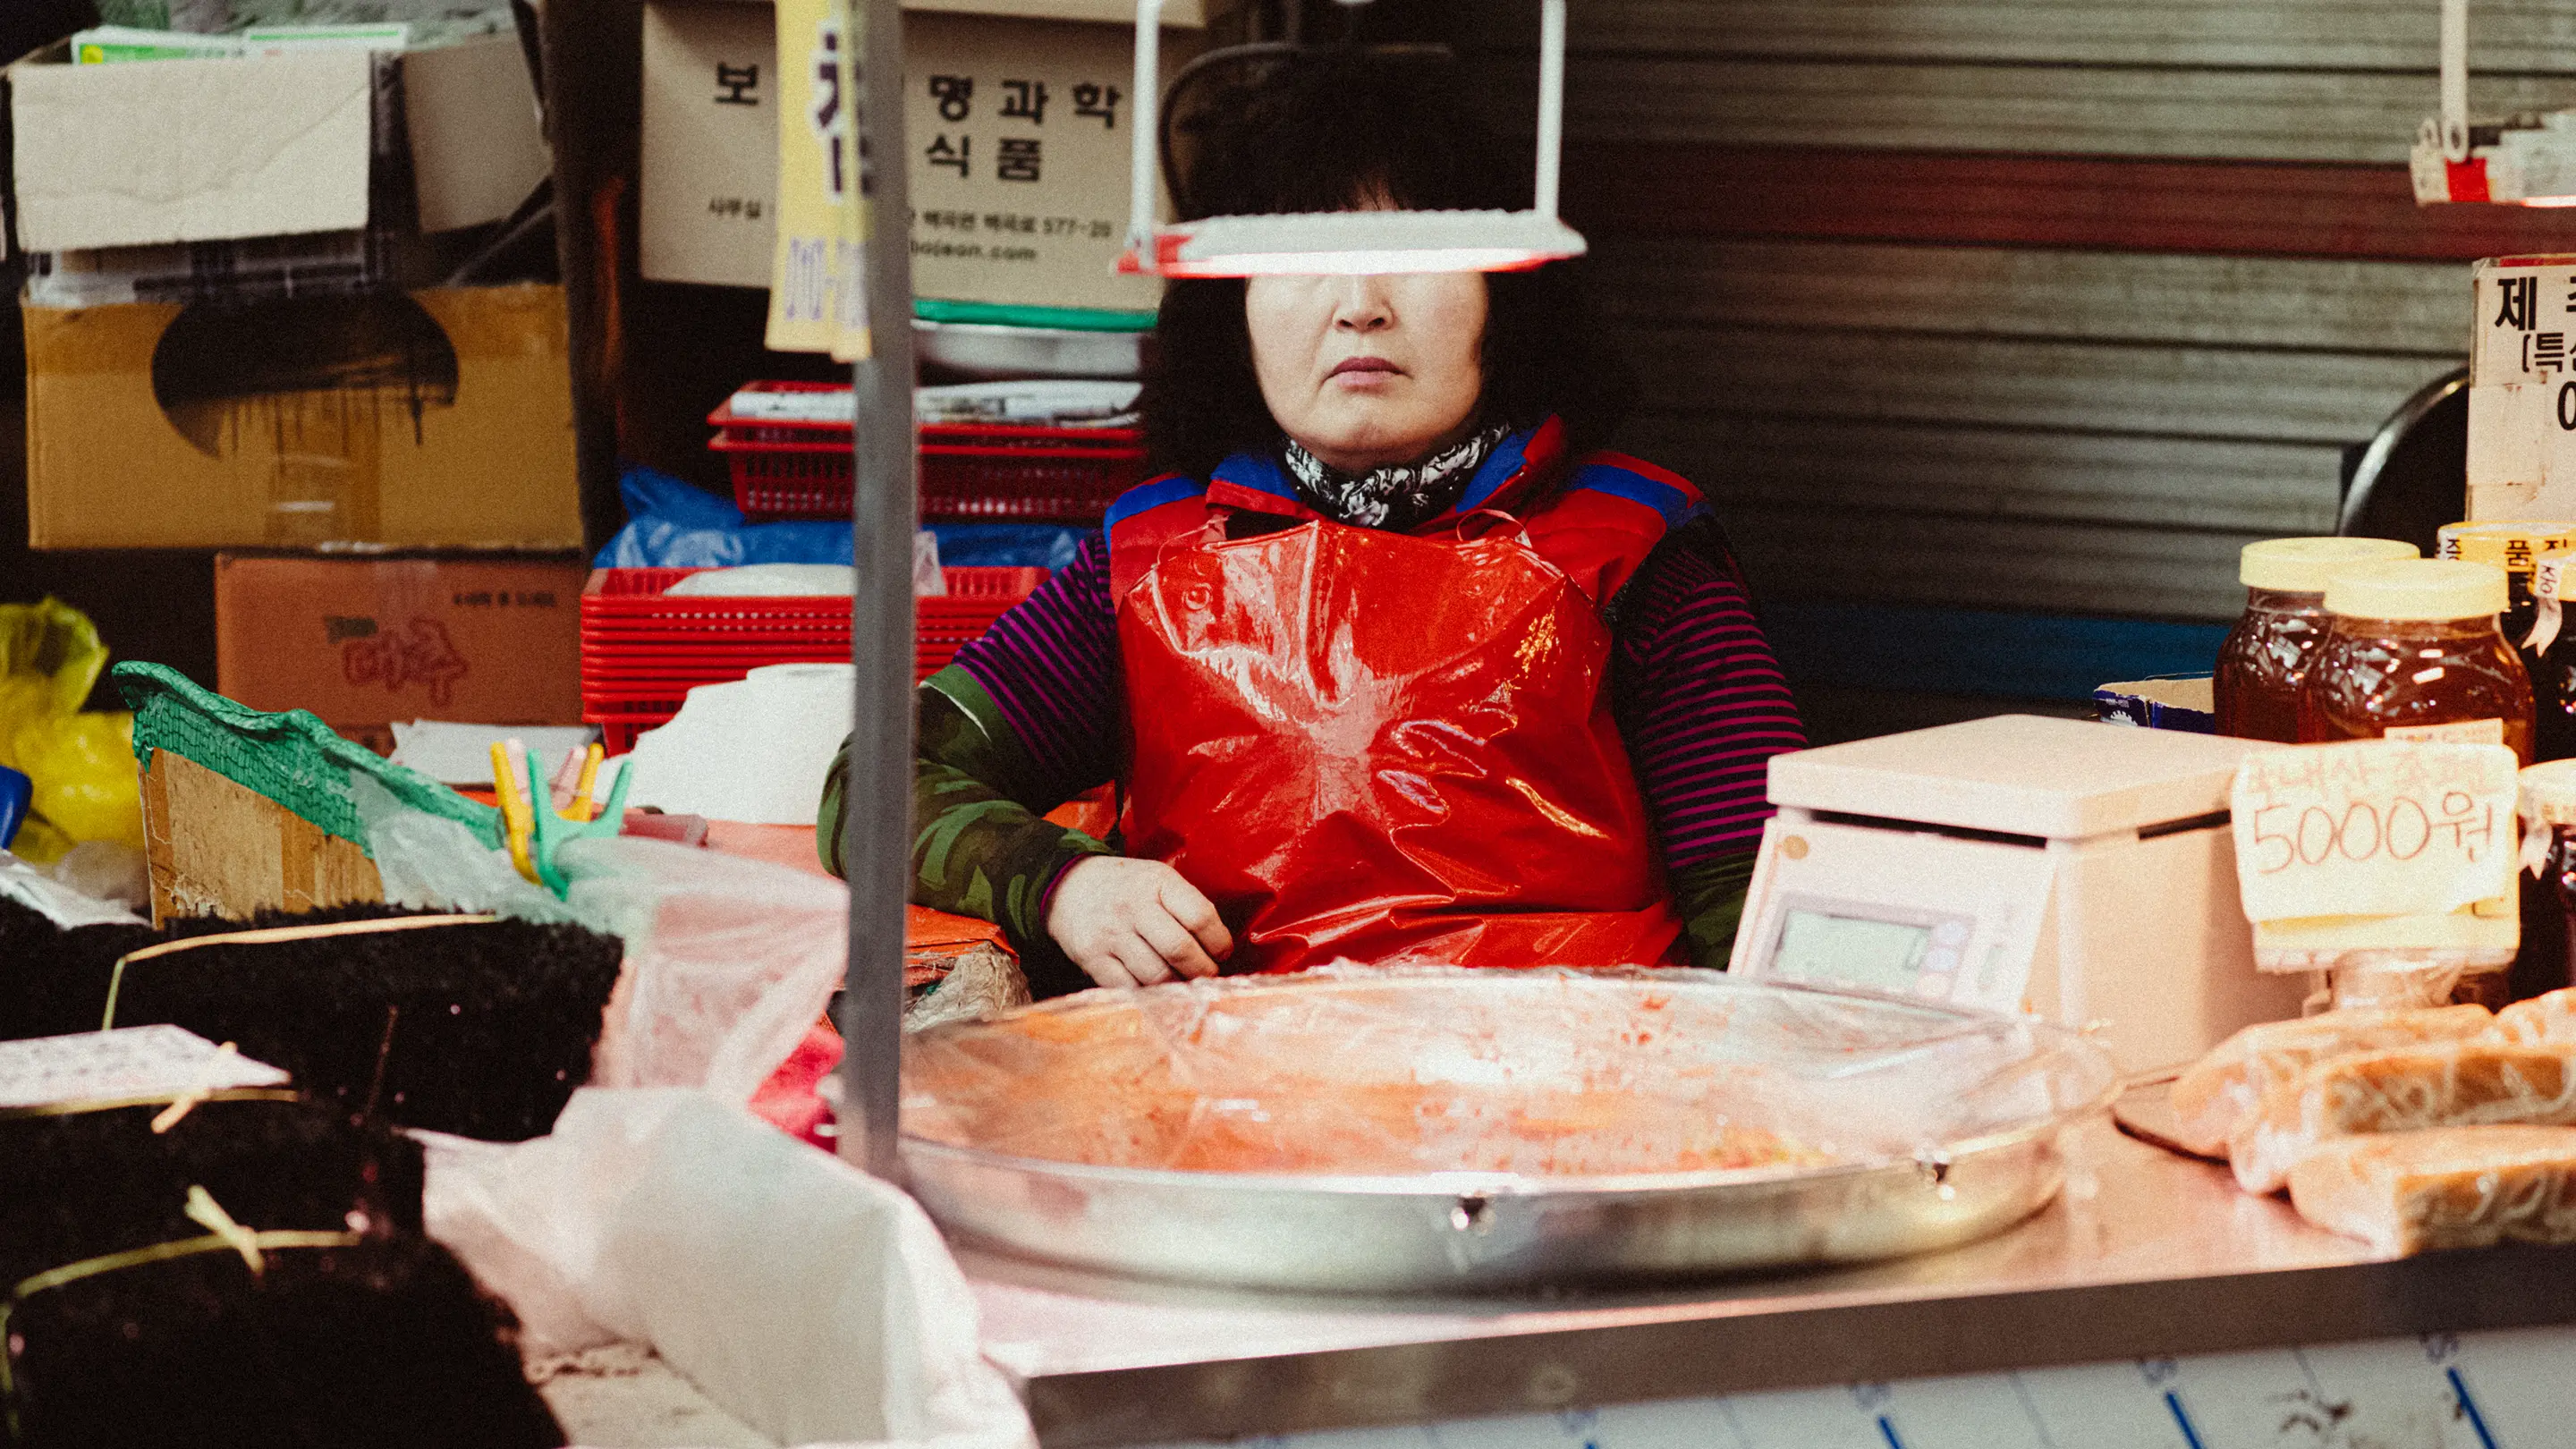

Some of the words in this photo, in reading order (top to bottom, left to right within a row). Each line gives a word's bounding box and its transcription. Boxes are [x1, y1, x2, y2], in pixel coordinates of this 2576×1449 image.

[925, 134, 1043, 182] 식품
[2522, 333, 2576, 373] [특
[2254, 791, 2494, 873] 5000원
